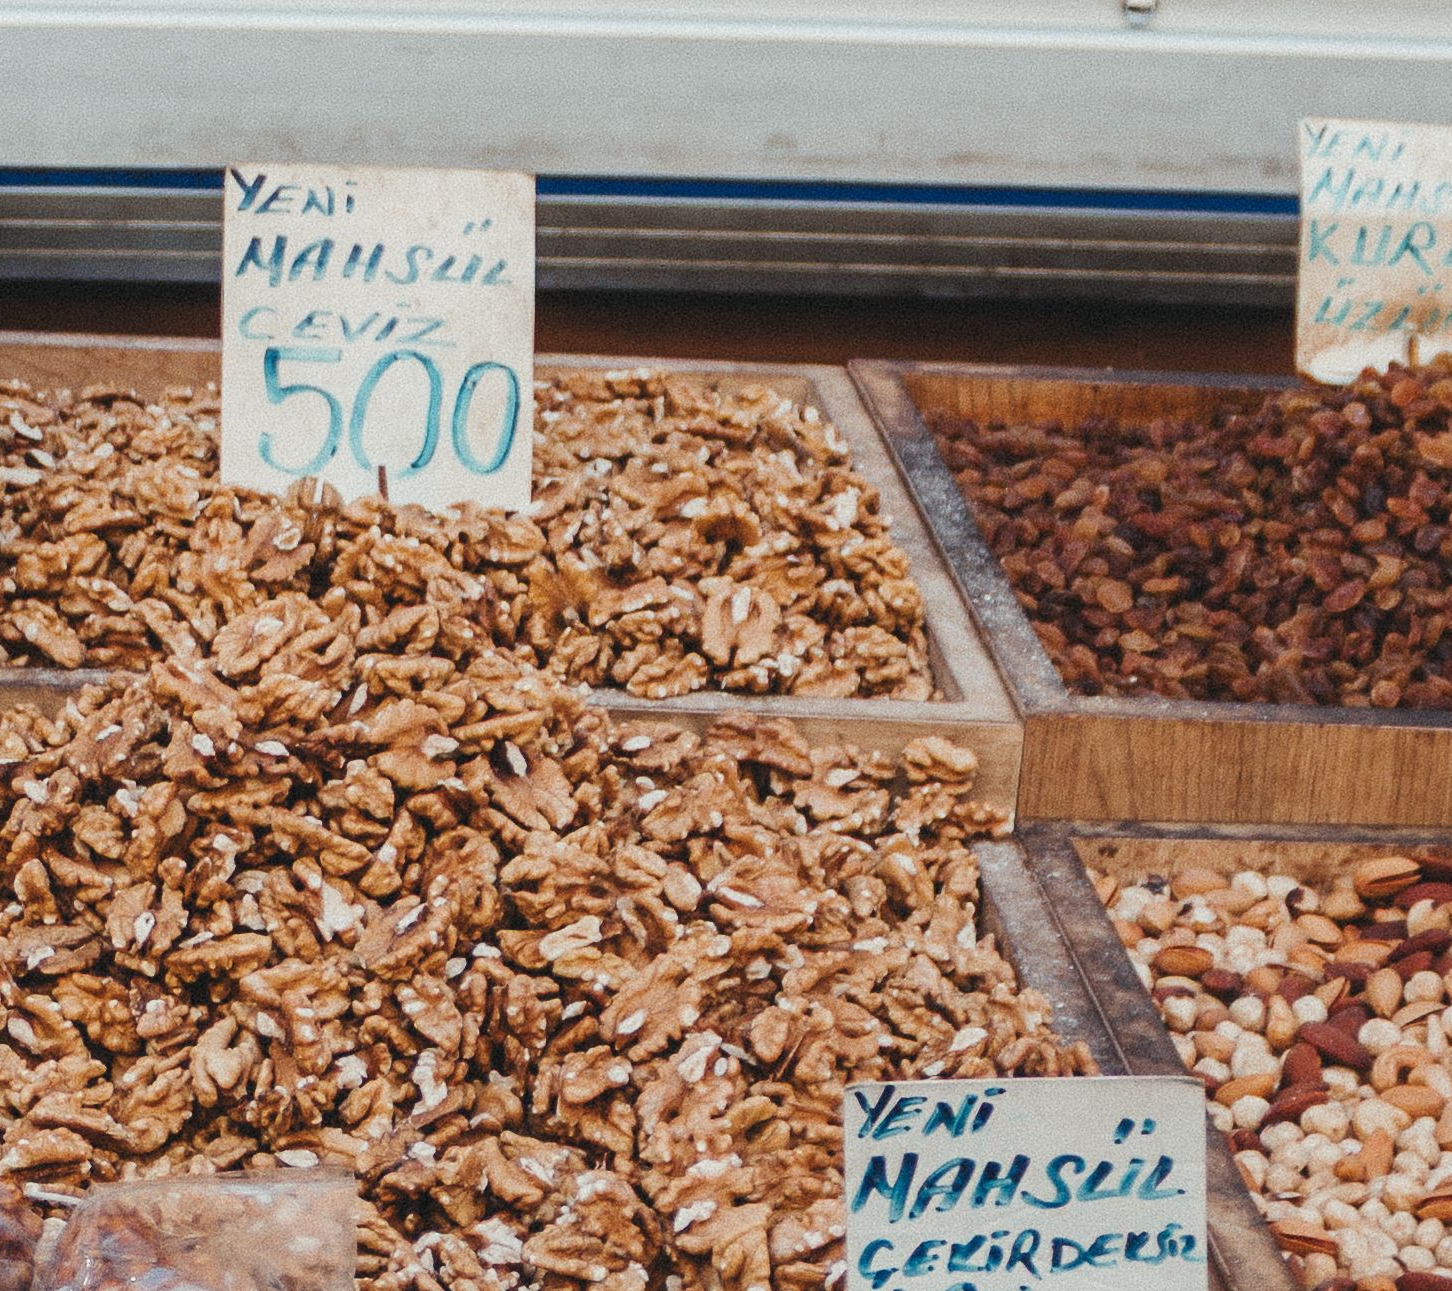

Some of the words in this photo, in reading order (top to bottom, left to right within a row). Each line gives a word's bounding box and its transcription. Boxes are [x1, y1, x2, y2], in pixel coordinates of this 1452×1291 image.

[230, 167, 358, 217] YENİ
[234, 218, 514, 288] MAHSÜL
[238, 301, 458, 347] CEVİZ
[257, 346, 521, 479] 500
[854, 1084, 1007, 1140] YENİ
[851, 1117, 1186, 1224] MAHSÜL
